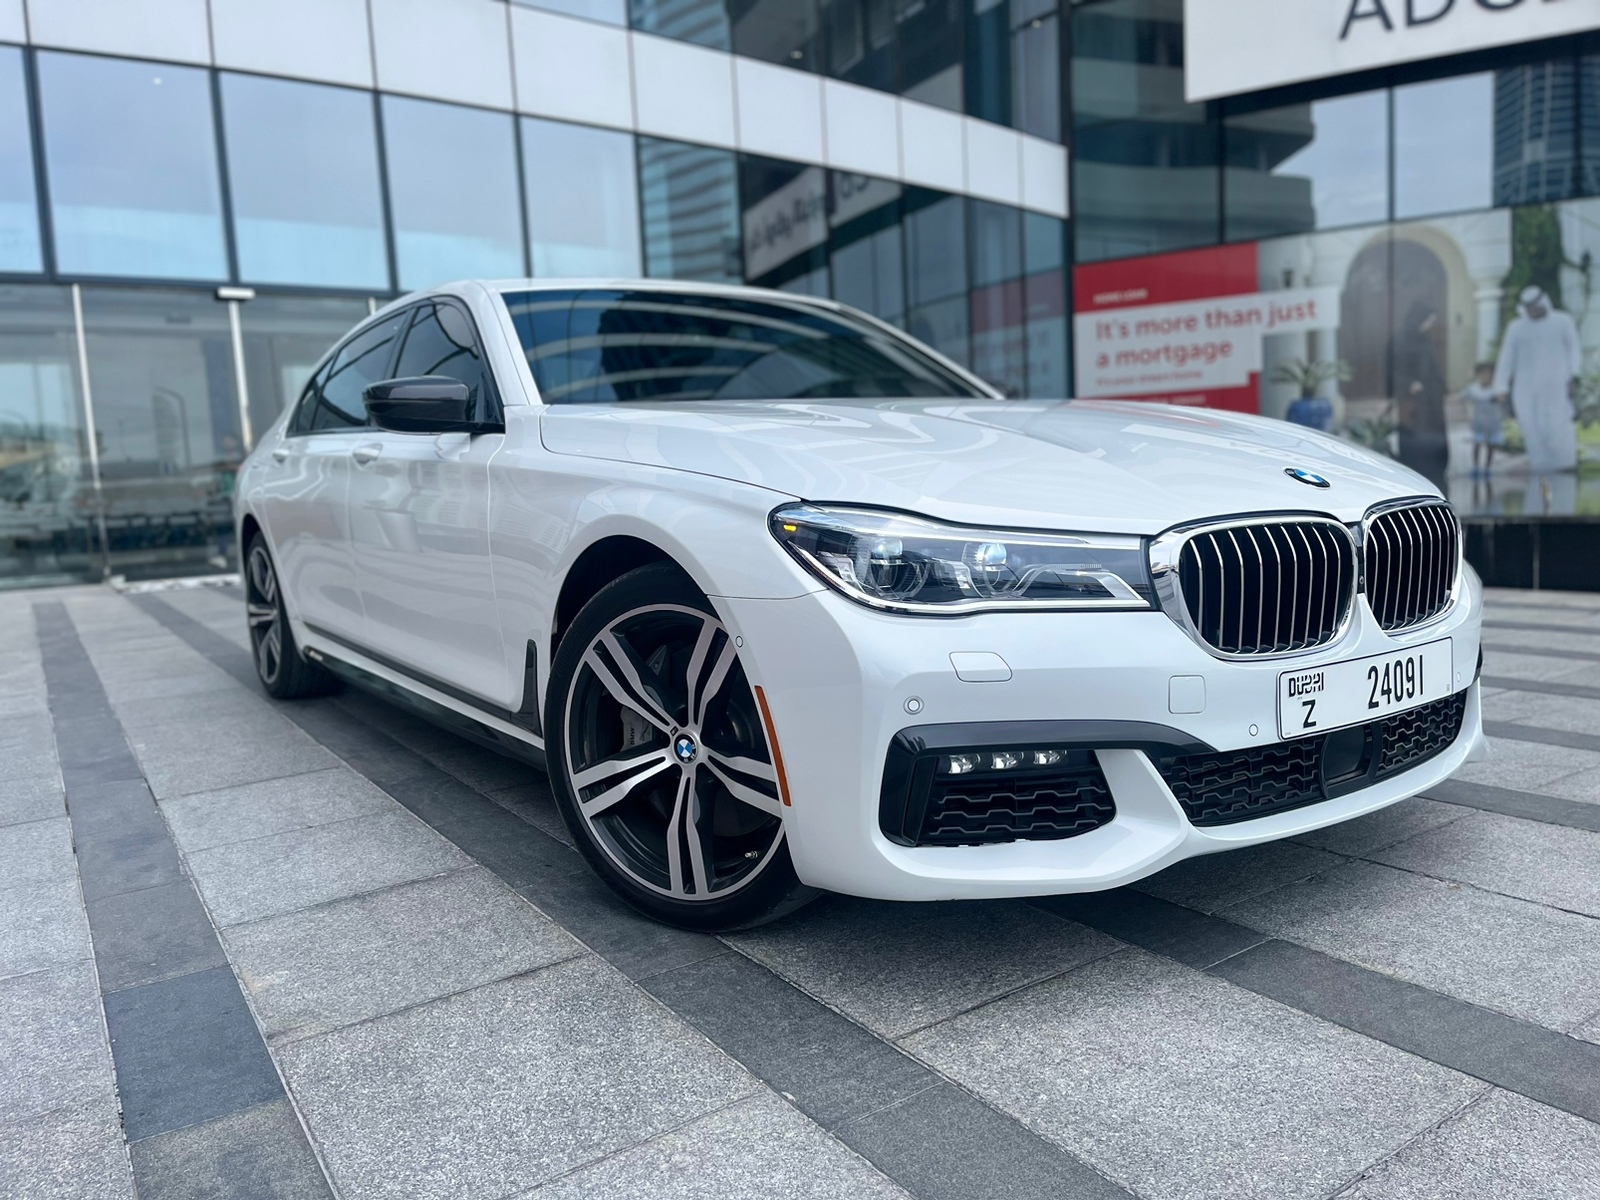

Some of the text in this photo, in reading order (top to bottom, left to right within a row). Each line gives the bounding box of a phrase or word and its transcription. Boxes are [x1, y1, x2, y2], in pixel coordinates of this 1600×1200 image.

[1096, 299, 1317, 341] It's more than just
[1096, 340, 1233, 368] a mortgage
[1288, 671, 1324, 697] DUBAI
[1367, 654, 1423, 709] 24091
[1302, 699, 1316, 728] Z
